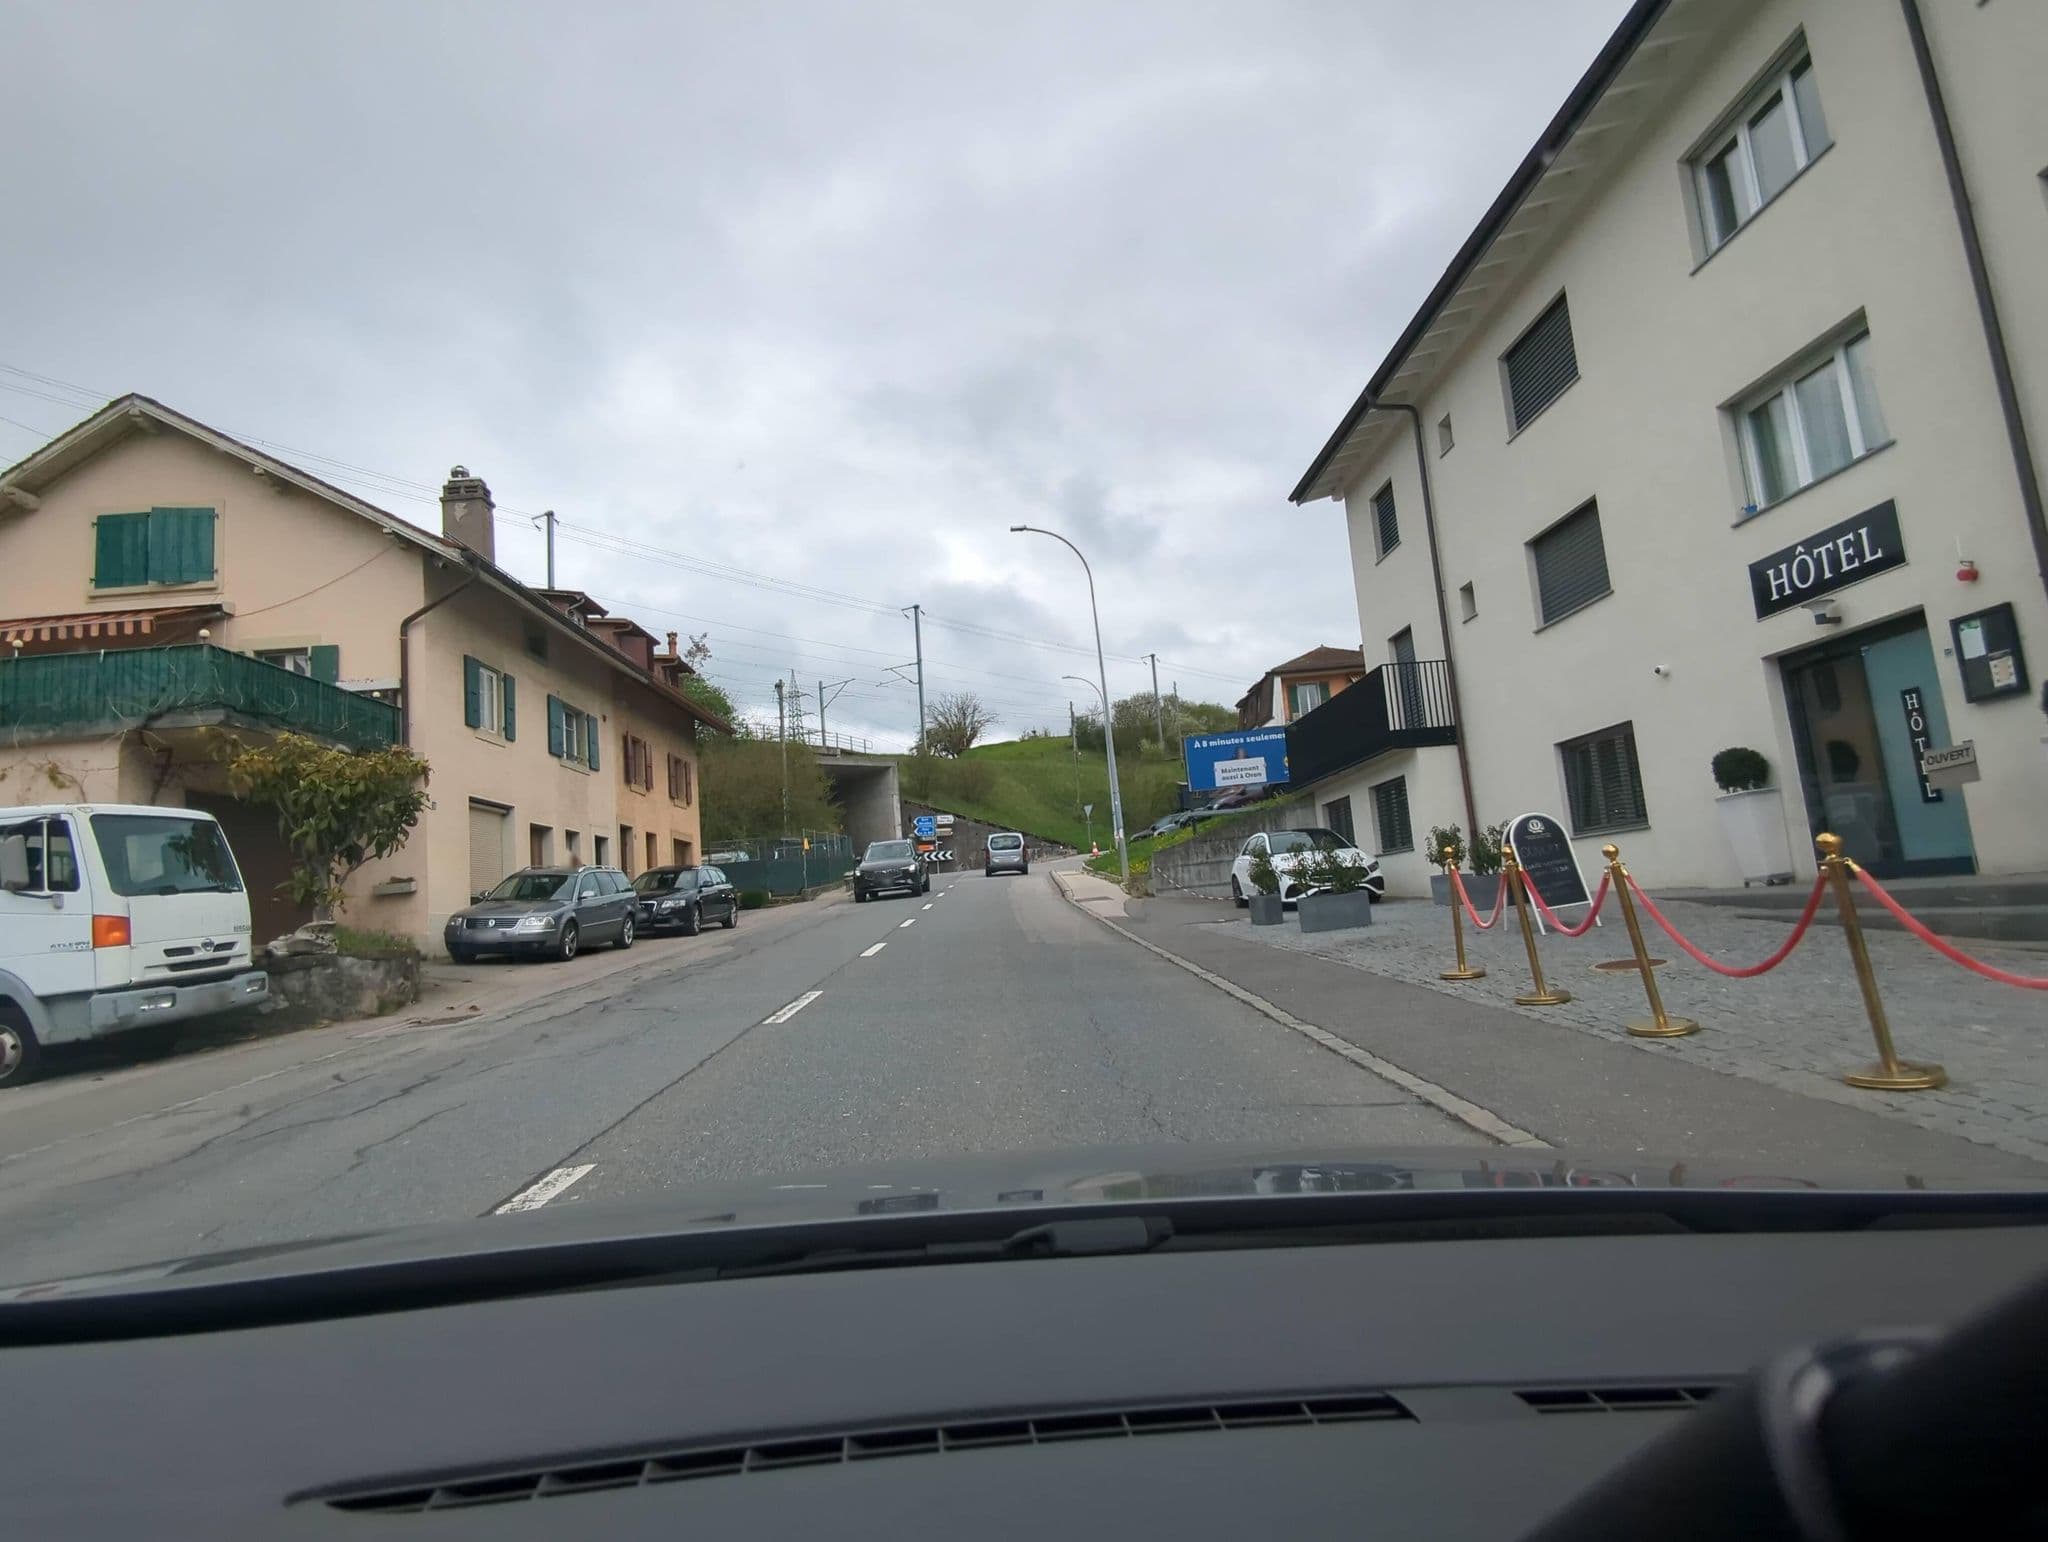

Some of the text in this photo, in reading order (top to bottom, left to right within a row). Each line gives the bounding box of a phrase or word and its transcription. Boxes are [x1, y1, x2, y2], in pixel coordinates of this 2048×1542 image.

[1766, 526, 1883, 601] HÔTEL
[1209, 737, 1244, 747] minutes
[1926, 747, 1971, 766] OUVERT
[1221, 765, 1260, 774] Maintenant
